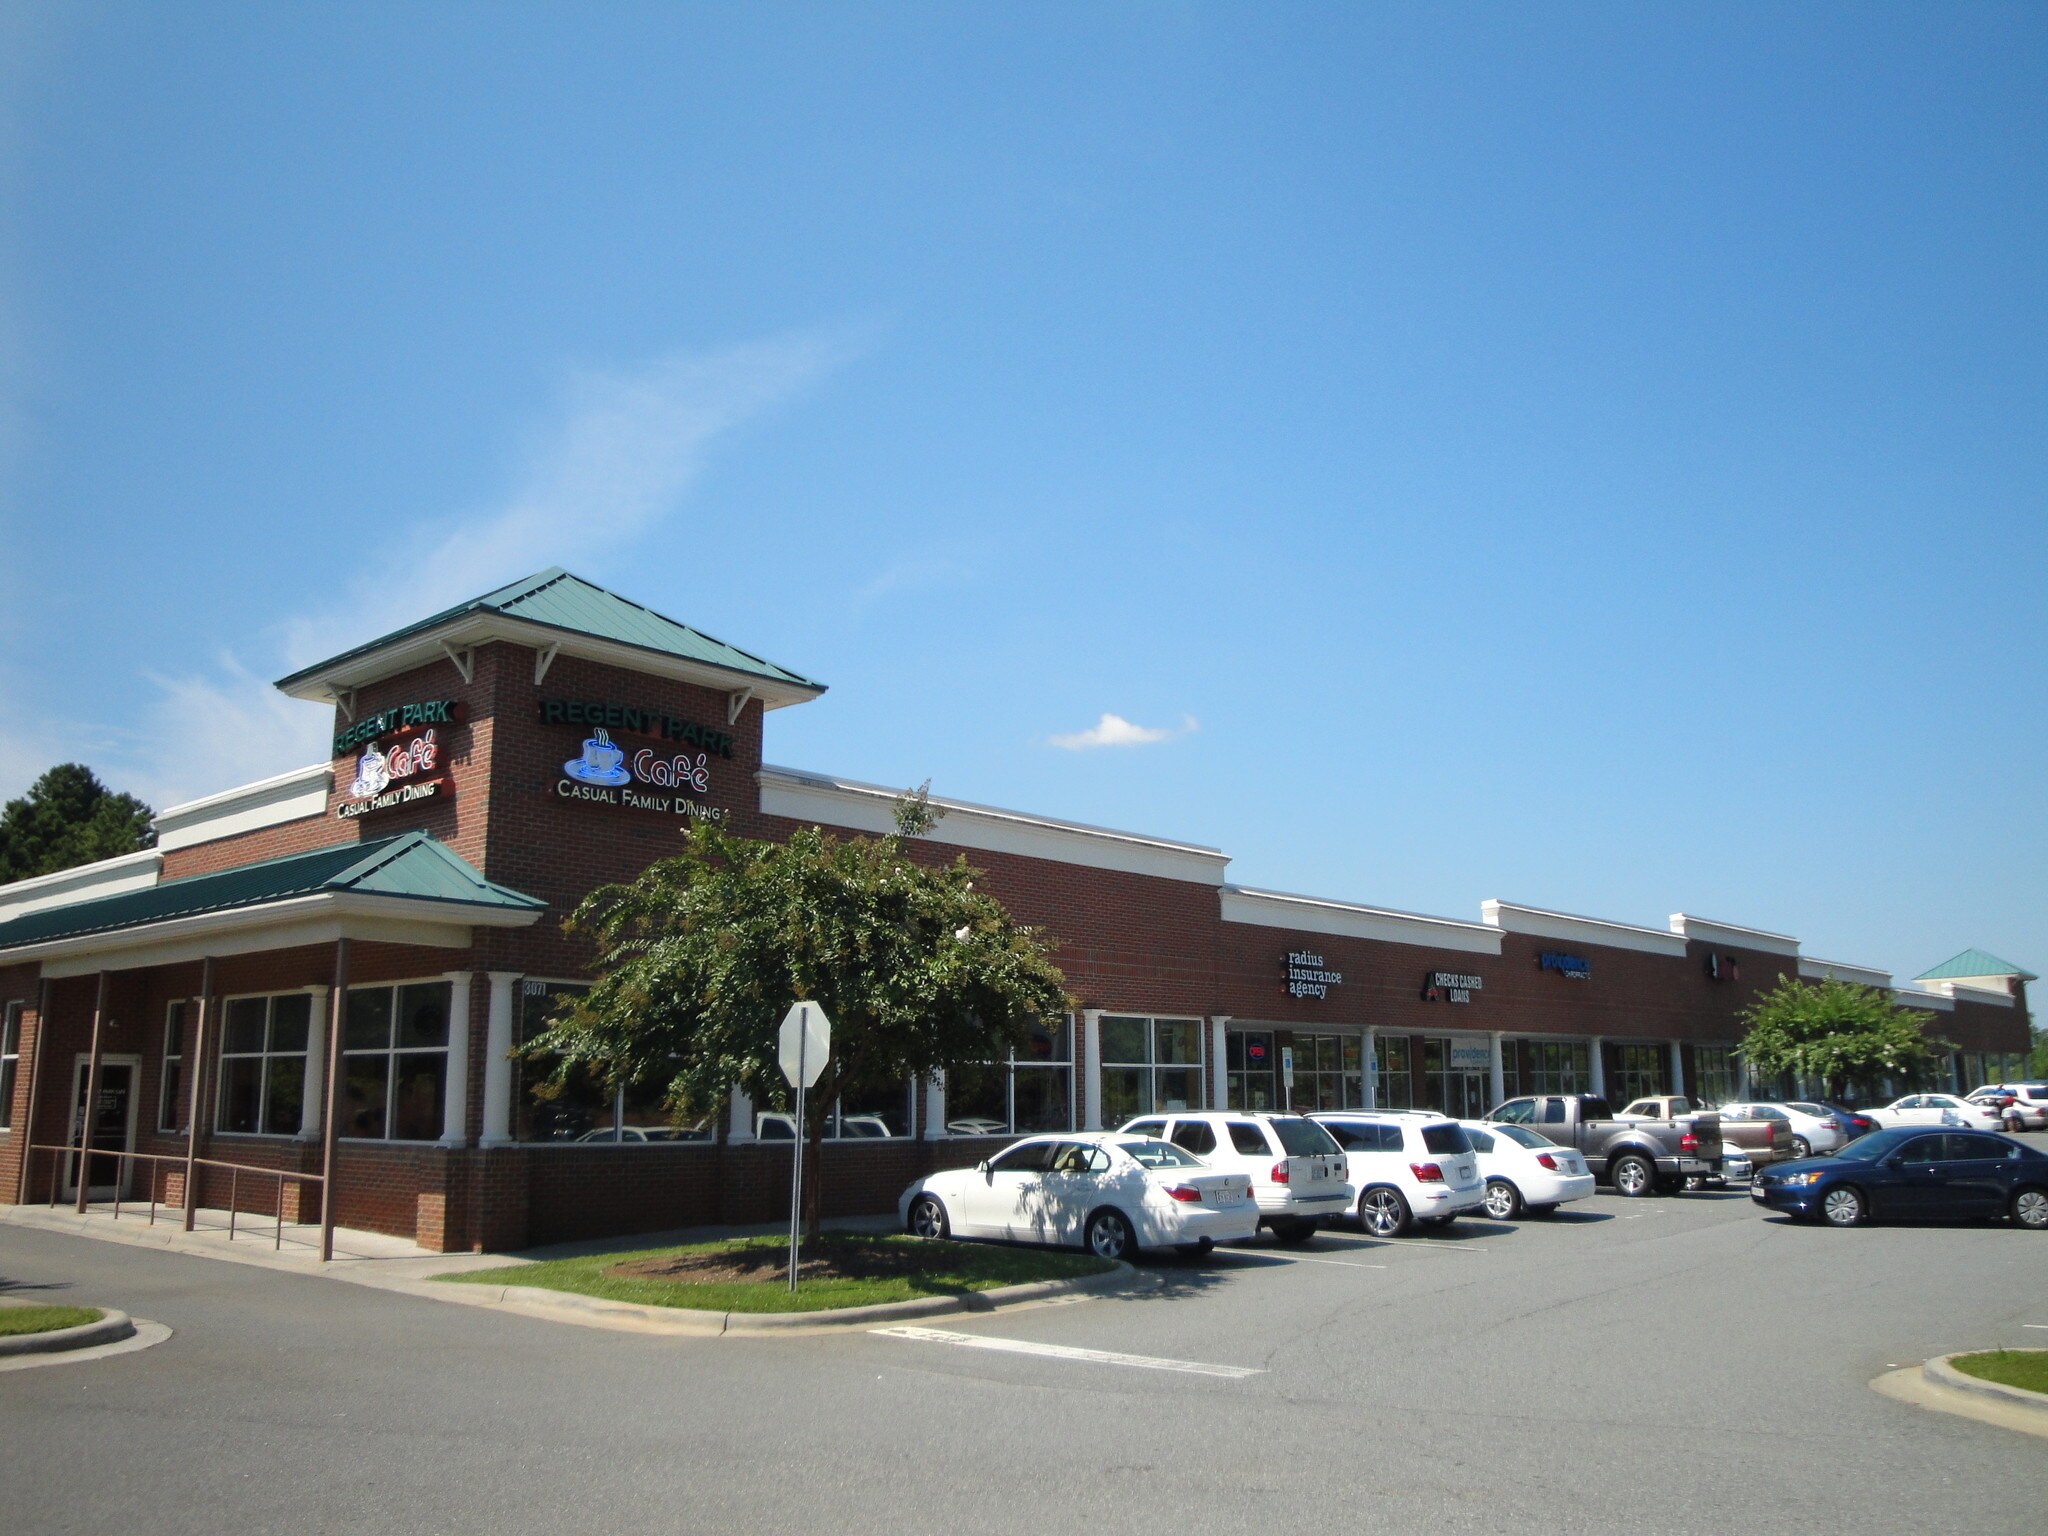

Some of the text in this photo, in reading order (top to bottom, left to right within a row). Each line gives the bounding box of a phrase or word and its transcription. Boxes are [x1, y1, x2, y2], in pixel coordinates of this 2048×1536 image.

[335, 701, 451, 753] REGENT PARK
[545, 701, 735, 758] REGENT PARK
[387, 728, 437, 779] Café
[633, 748, 710, 793] Café
[337, 783, 436, 819] CASUAL FAMILY DINING
[557, 780, 721, 820] CASUAL FAMILY DINING
[1288, 950, 1324, 966] radius
[1289, 964, 1342, 983] insurance
[1435, 972, 1482, 989] CHECKS CASHED
[524, 982, 547, 996] 3071
[1289, 981, 1327, 999] agency
[1450, 989, 1470, 1003] LOANS
[1452, 1047, 1490, 1062] providenc
